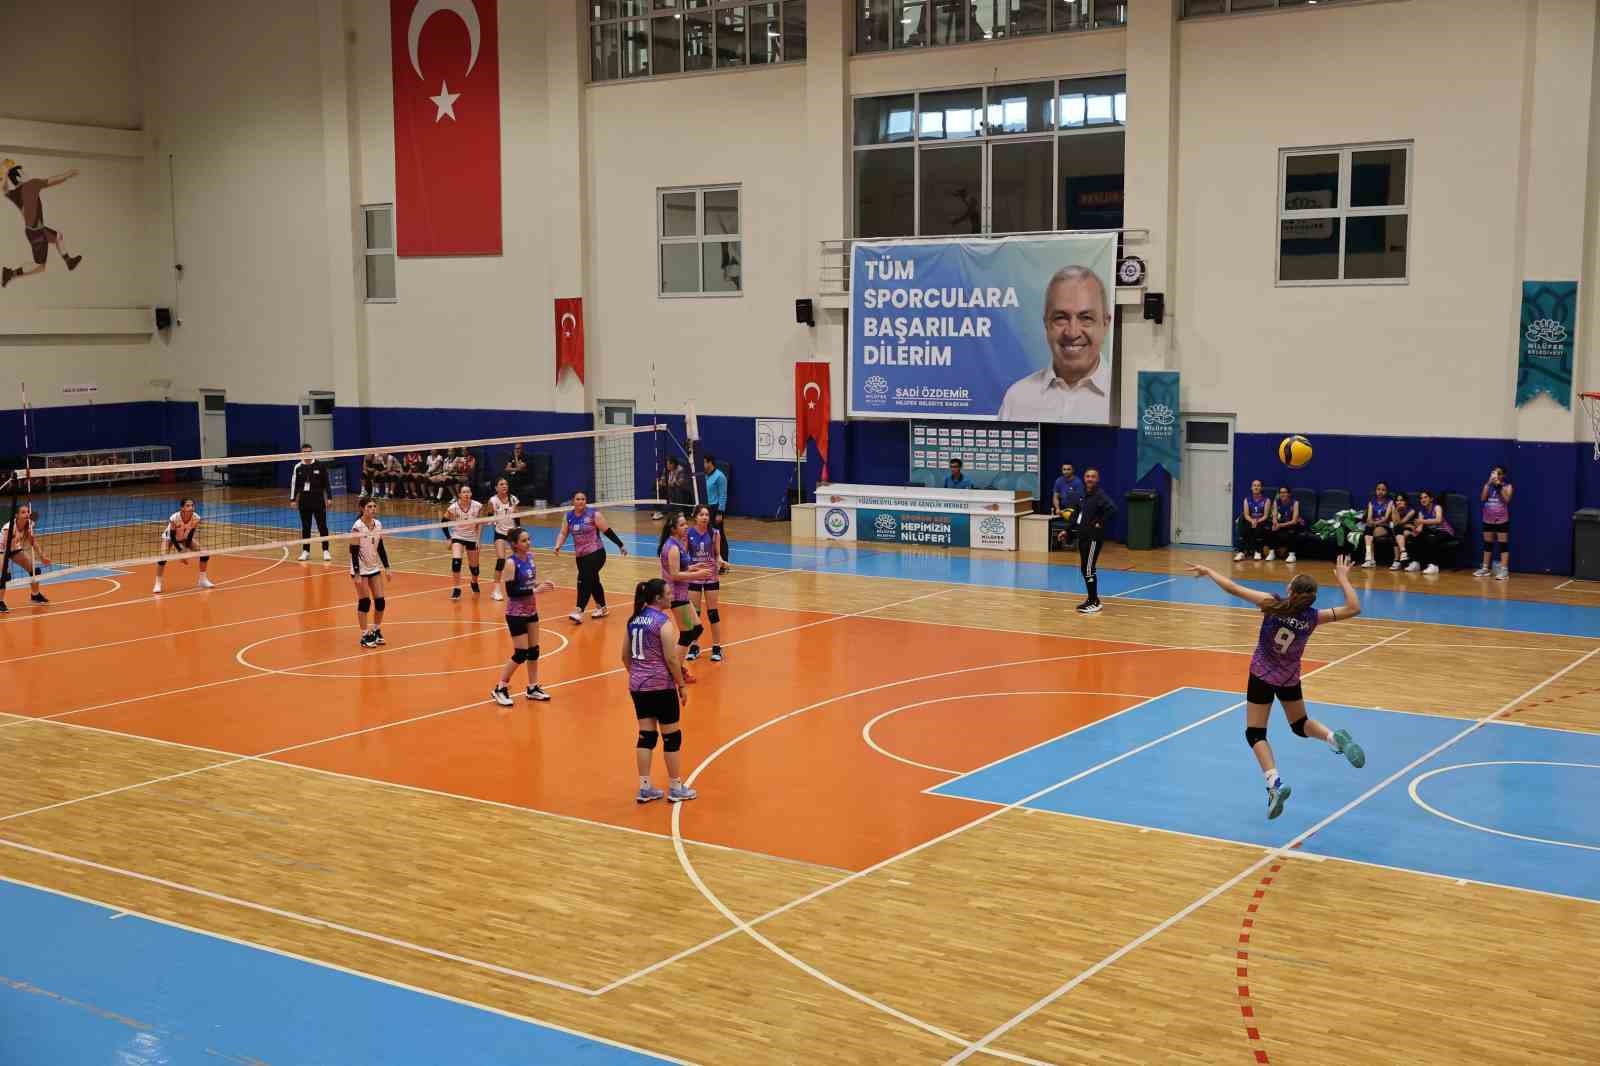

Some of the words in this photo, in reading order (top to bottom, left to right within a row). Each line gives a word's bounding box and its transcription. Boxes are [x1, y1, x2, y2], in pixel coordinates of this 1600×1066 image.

[864, 255, 914, 281] TÜM
[864, 287, 1020, 309] SPORCULARA
[864, 316, 992, 343] BAŞARILAR
[864, 340, 952, 367] DİLERİM
[895, 386, 919, 398] SADİ
[921, 386, 969, 399] ÖZDEMİR
[901, 521, 951, 533] HEPİMİZİN
[901, 531, 951, 544] NİLÜFER'İ
[631, 628, 646, 660] 11
[1273, 627, 1296, 655] 9
